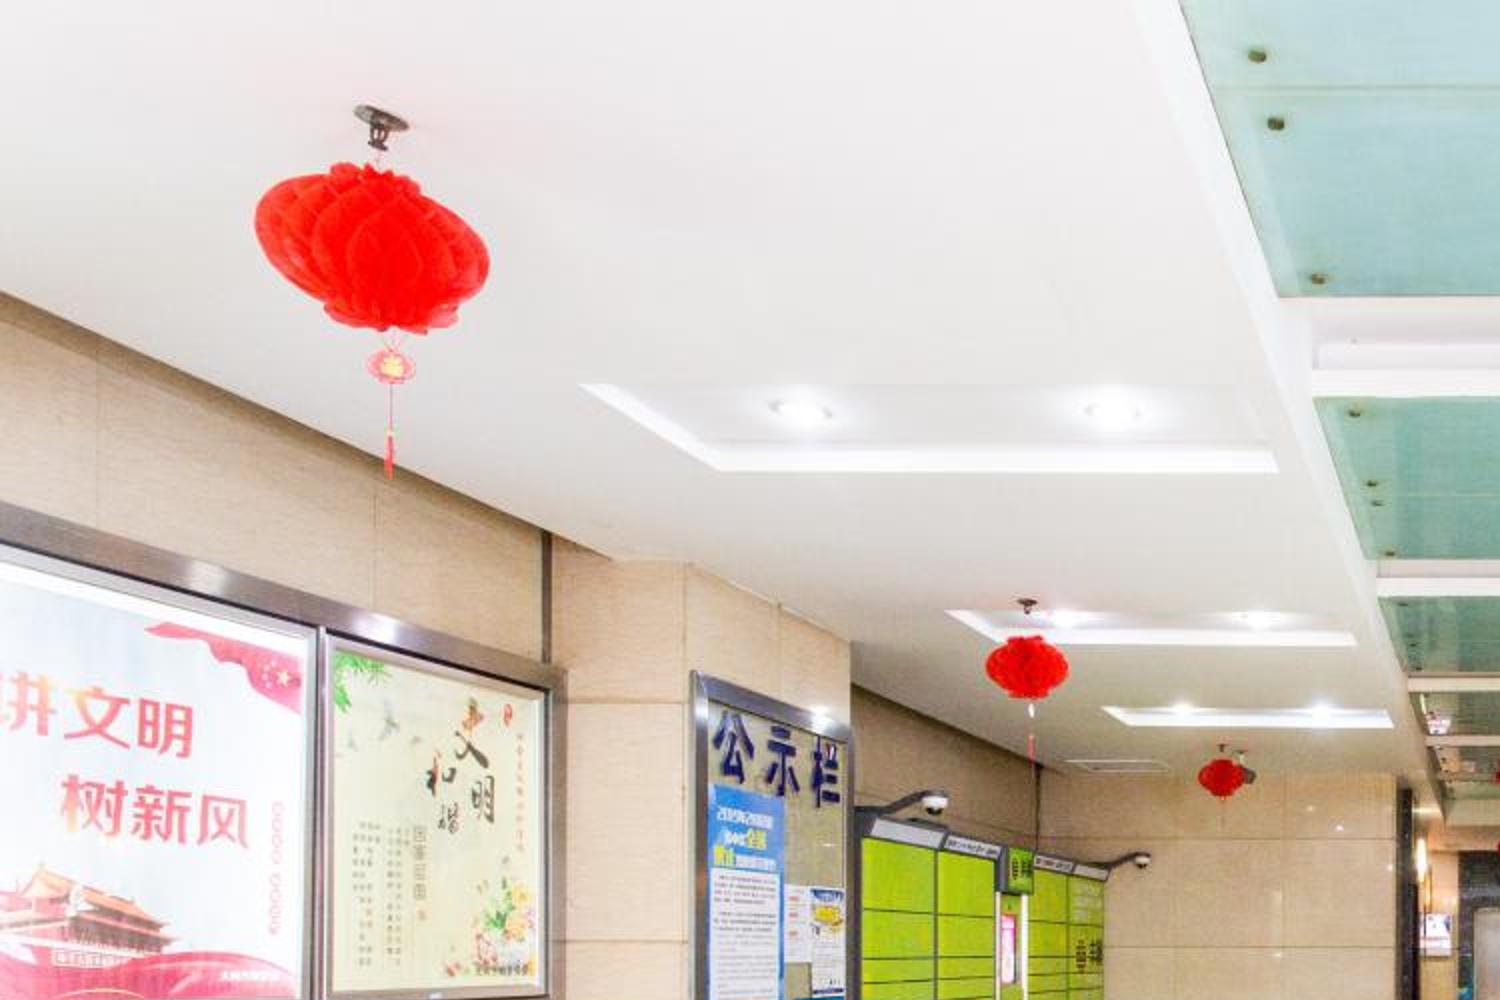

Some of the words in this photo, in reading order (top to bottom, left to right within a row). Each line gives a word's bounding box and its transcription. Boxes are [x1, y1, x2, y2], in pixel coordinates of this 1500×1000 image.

[712, 712, 841, 808] 公示栏
[60, 774, 250, 849] 树新风
